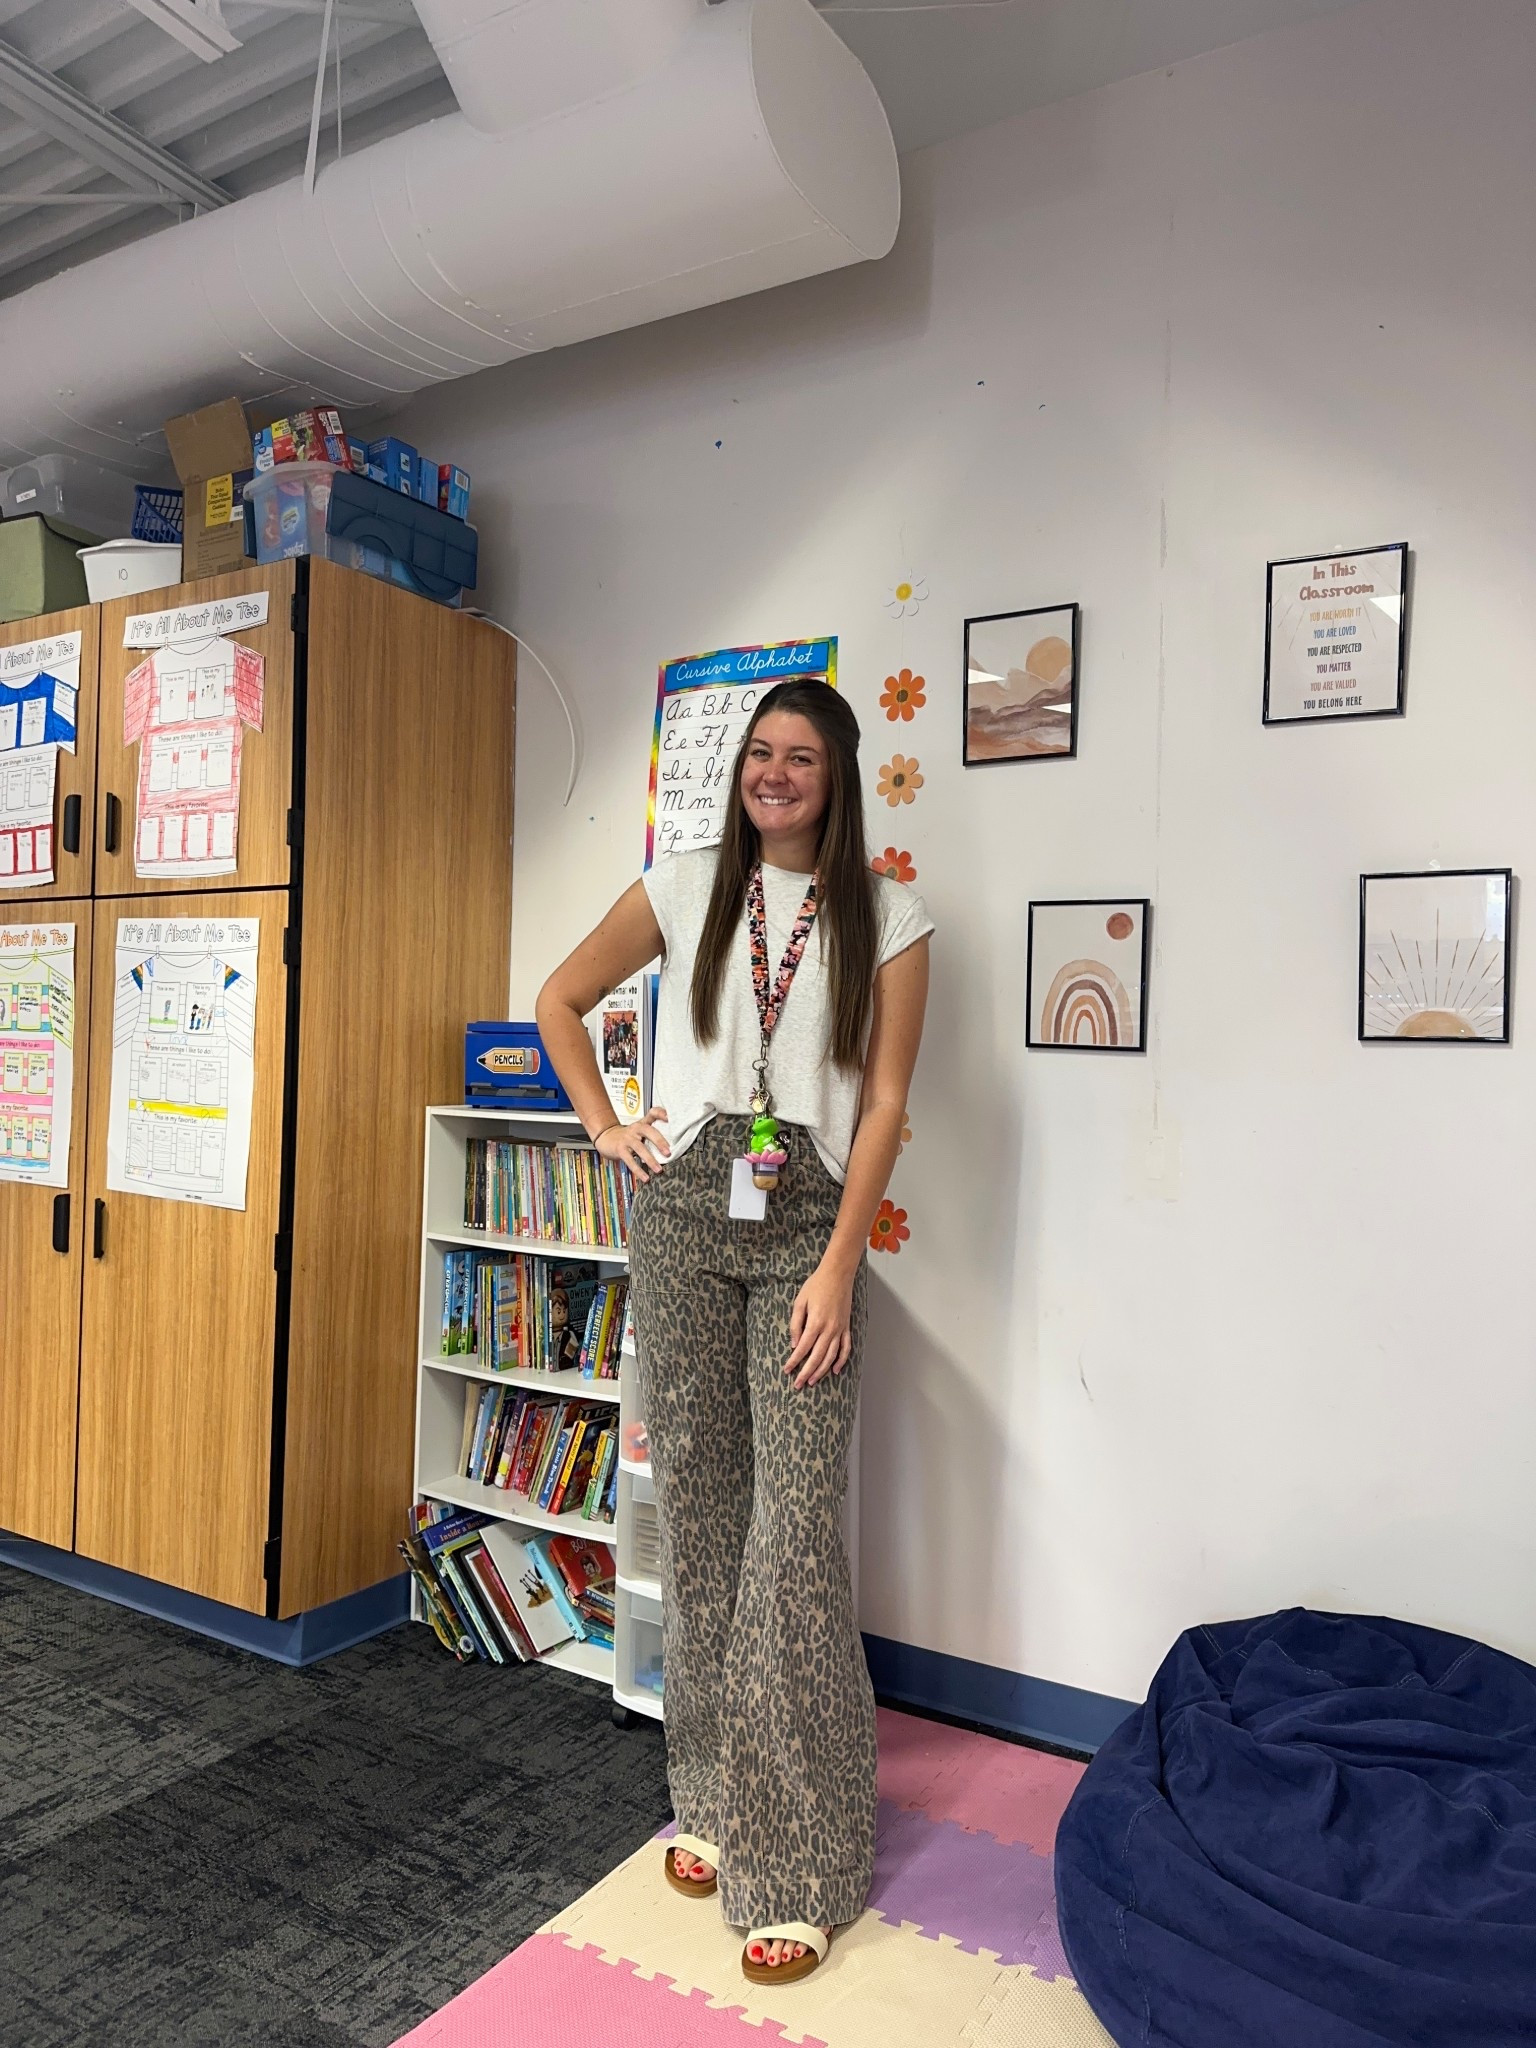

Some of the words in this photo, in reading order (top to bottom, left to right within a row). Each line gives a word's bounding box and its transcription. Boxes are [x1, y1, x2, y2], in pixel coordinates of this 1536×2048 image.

[1312, 565, 1326, 580] In
[1329, 562, 1357, 578] This
[1300, 584, 1375, 601] Classroom
[131, 620, 152, 639] It's
[155, 616, 170, 636] All
[174, 609, 210, 633] About
[212, 605, 233, 625] Me
[236, 602, 260, 620] Tee
[1310, 612, 1320, 622] YOU
[1322, 610, 1332, 620] ARE
[1356, 607, 1362, 617] IT
[1314, 629, 1325, 639] YOU
[1326, 628, 1337, 638] ARE
[1338, 625, 1357, 636] LOVED
[4, 647, 34, 670] About
[36, 644, 54, 662] Me
[56, 640, 74, 656] Tee
[1307, 648, 1318, 658] YOU
[1320, 646, 1330, 656] ARE
[1332, 642, 1362, 655] RESPECTED
[676, 662, 731, 681] Cursive
[736, 645, 813, 677] Alphabet
[1316, 664, 1328, 674] YOU
[1328, 662, 1352, 672] MATTER
[1310, 682, 1322, 692] YOU
[1322, 681, 1334, 691] ARE
[1335, 678, 1357, 690] VALUED
[1304, 700, 1316, 710] YOU
[1318, 698, 1343, 708] BELONG
[1345, 696, 1362, 707] HERE
[0, 930, 29, 948] About
[32, 930, 47, 946] Me
[50, 928, 68, 946] Tee
[123, 924, 144, 943] It's
[146, 923, 162, 943] All
[165, 923, 202, 943] About
[204, 924, 224, 943] Me
[228, 924, 251, 942] Tee
[170, 1046, 184, 1054] things
[494, 1054, 523, 1066] PENCILS
[592, 1310, 602, 1340] PERFECT
[587, 1340, 598, 1362] SCORE
[439, 1526, 461, 1542] Inside
